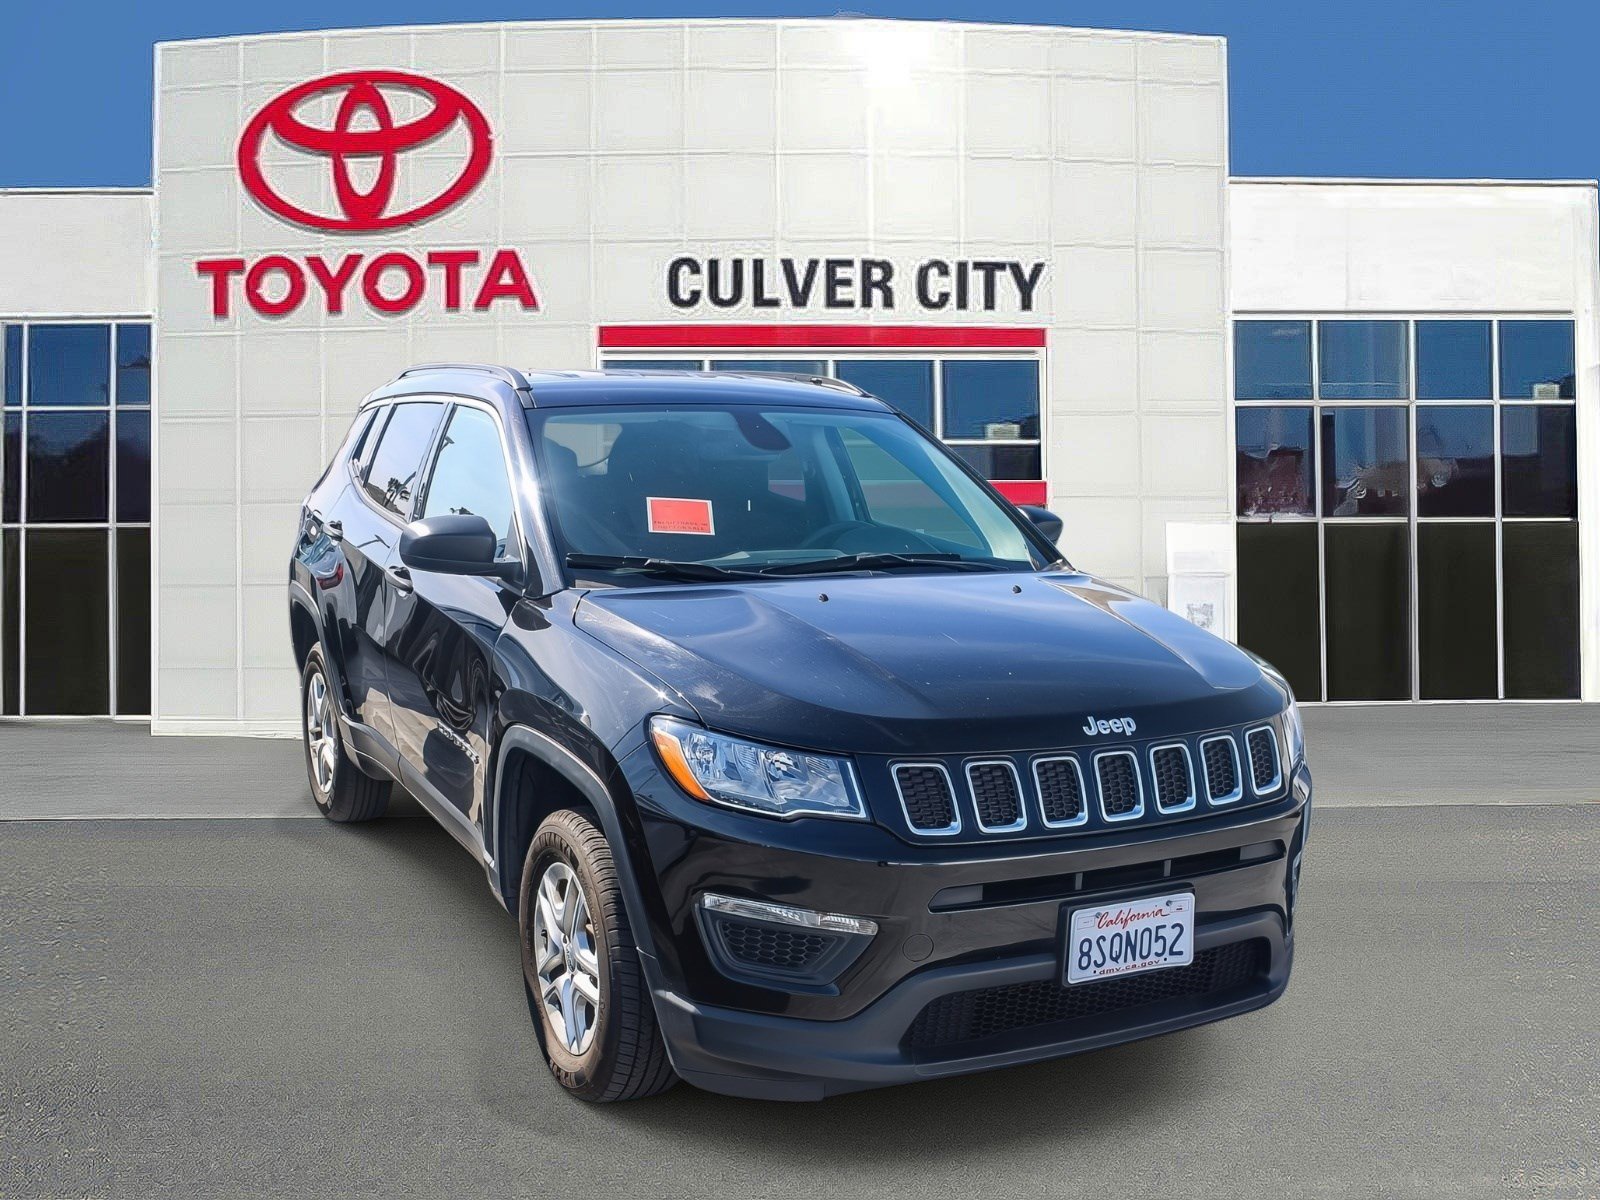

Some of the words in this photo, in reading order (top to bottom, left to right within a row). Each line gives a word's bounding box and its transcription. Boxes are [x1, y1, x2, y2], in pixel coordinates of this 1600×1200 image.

[196, 249, 539, 319] TOYOTA
[668, 257, 894, 309] CULVER
[916, 259, 1045, 311] CITY
[1082, 715, 1137, 737] Jeep
[1097, 904, 1170, 930] California
[1078, 922, 1185, 971] 8SQN052
[1098, 958, 1161, 976] dmv.ca.gov
